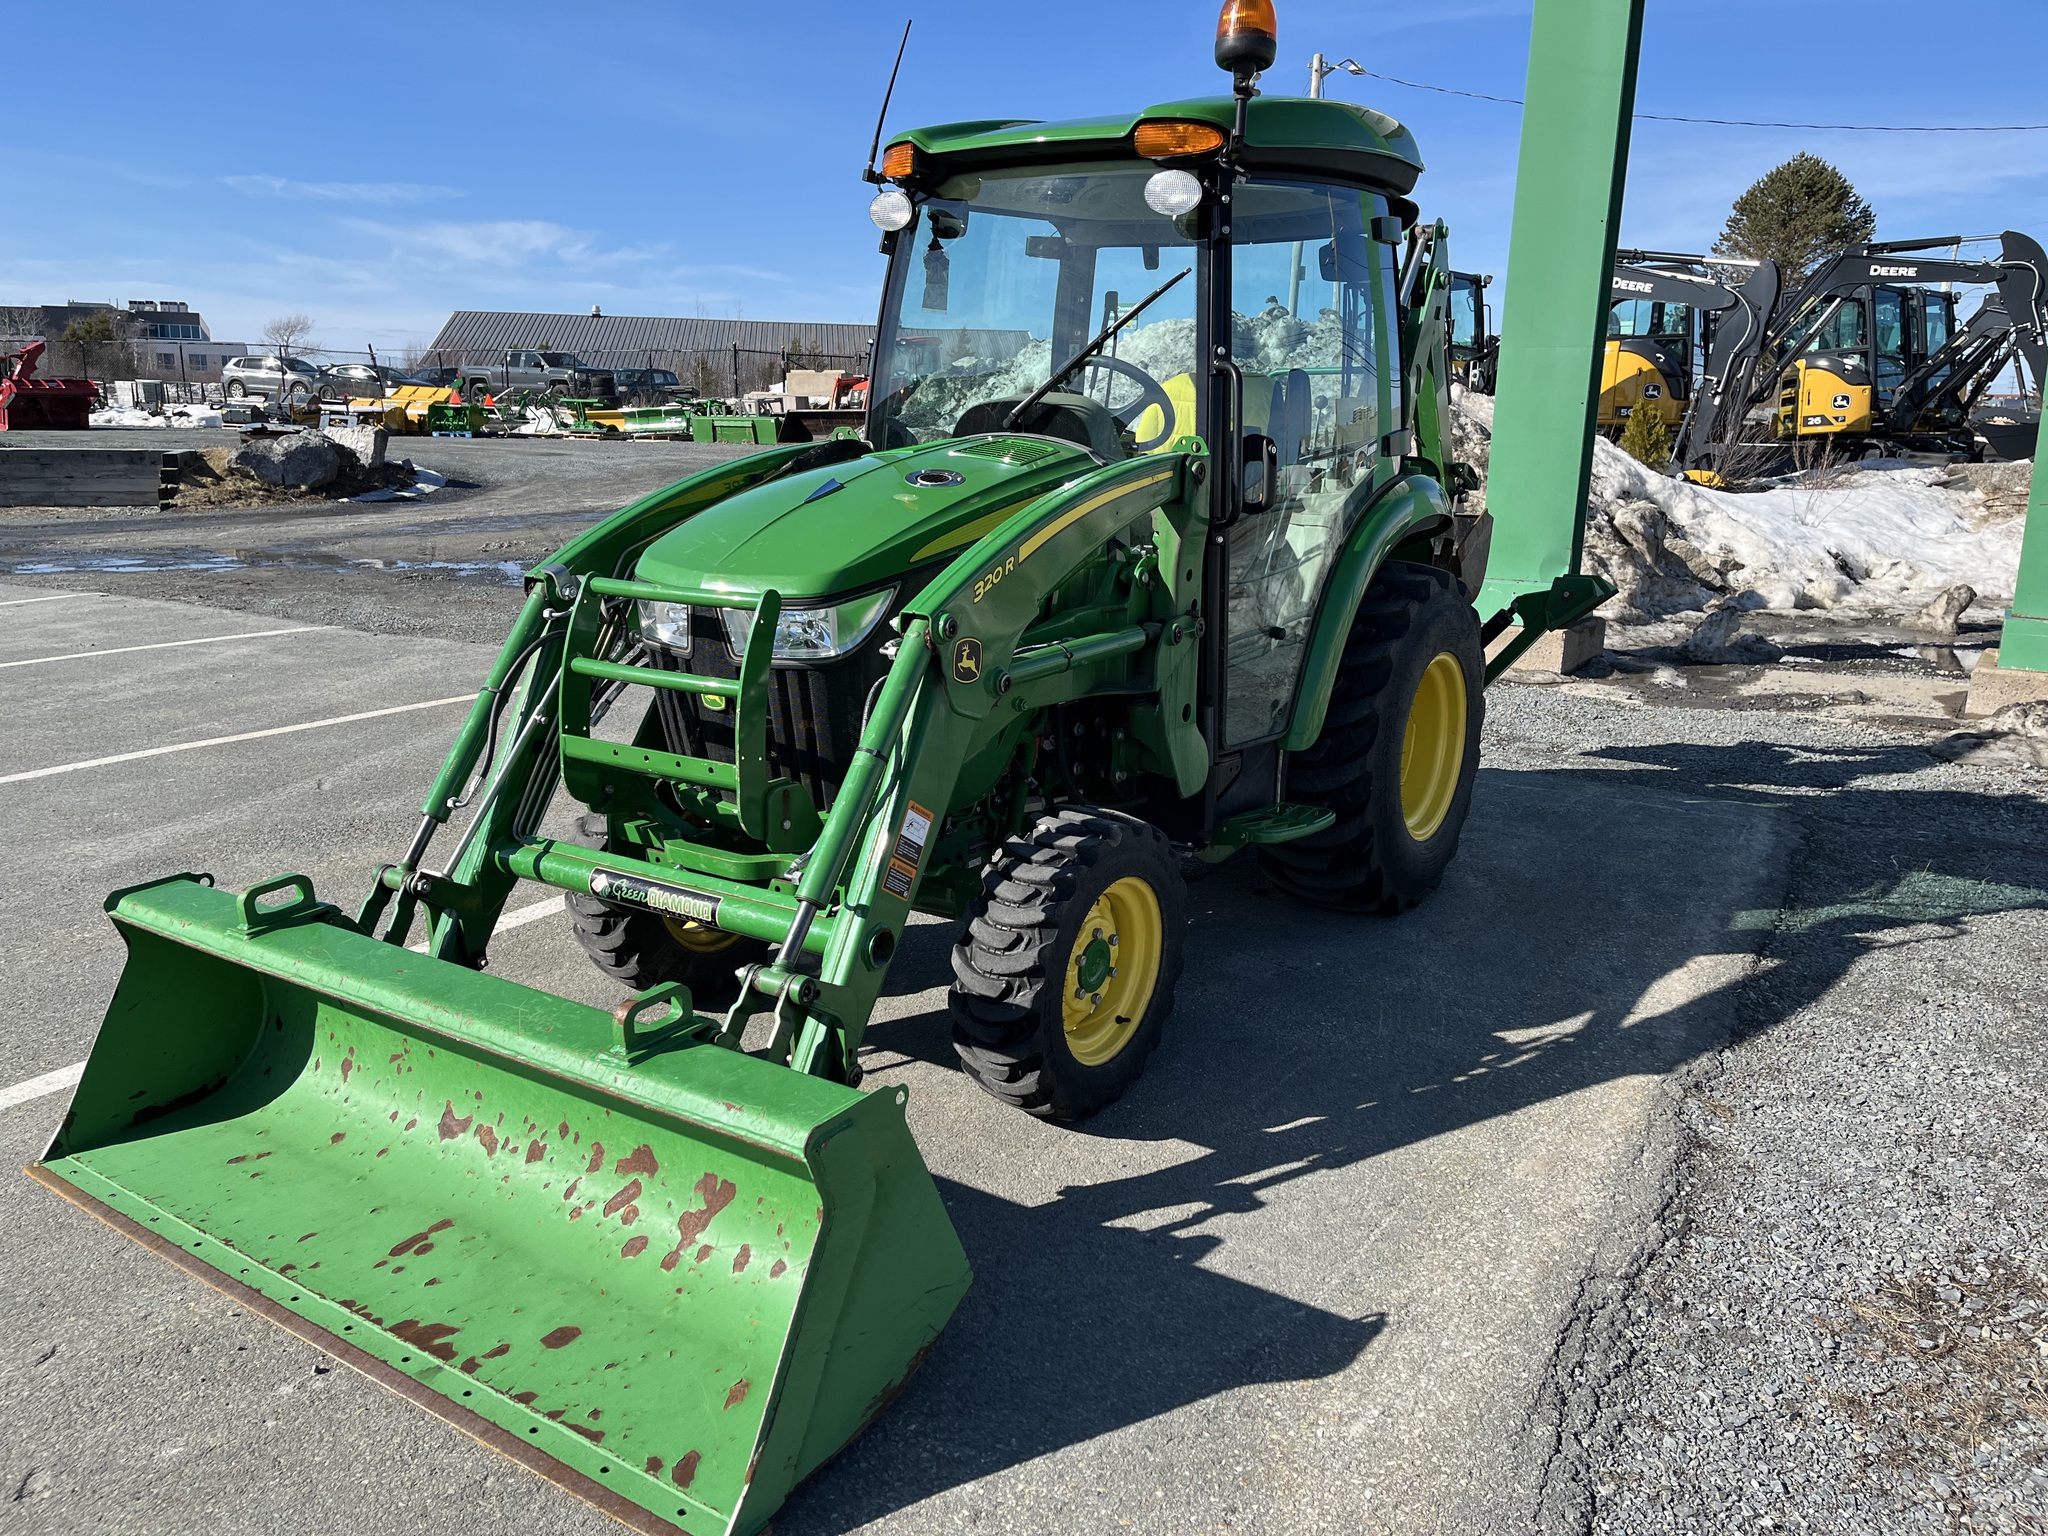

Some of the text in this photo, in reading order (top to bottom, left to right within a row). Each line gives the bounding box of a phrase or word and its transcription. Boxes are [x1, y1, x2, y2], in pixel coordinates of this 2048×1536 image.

[1869, 264, 1918, 277] DEERE
[1612, 276, 1654, 294] DEERE
[1807, 416, 1822, 425] 26
[974, 567, 1003, 603] 320
[612, 879, 648, 901] Green
[648, 888, 712, 921] DIAMOND
